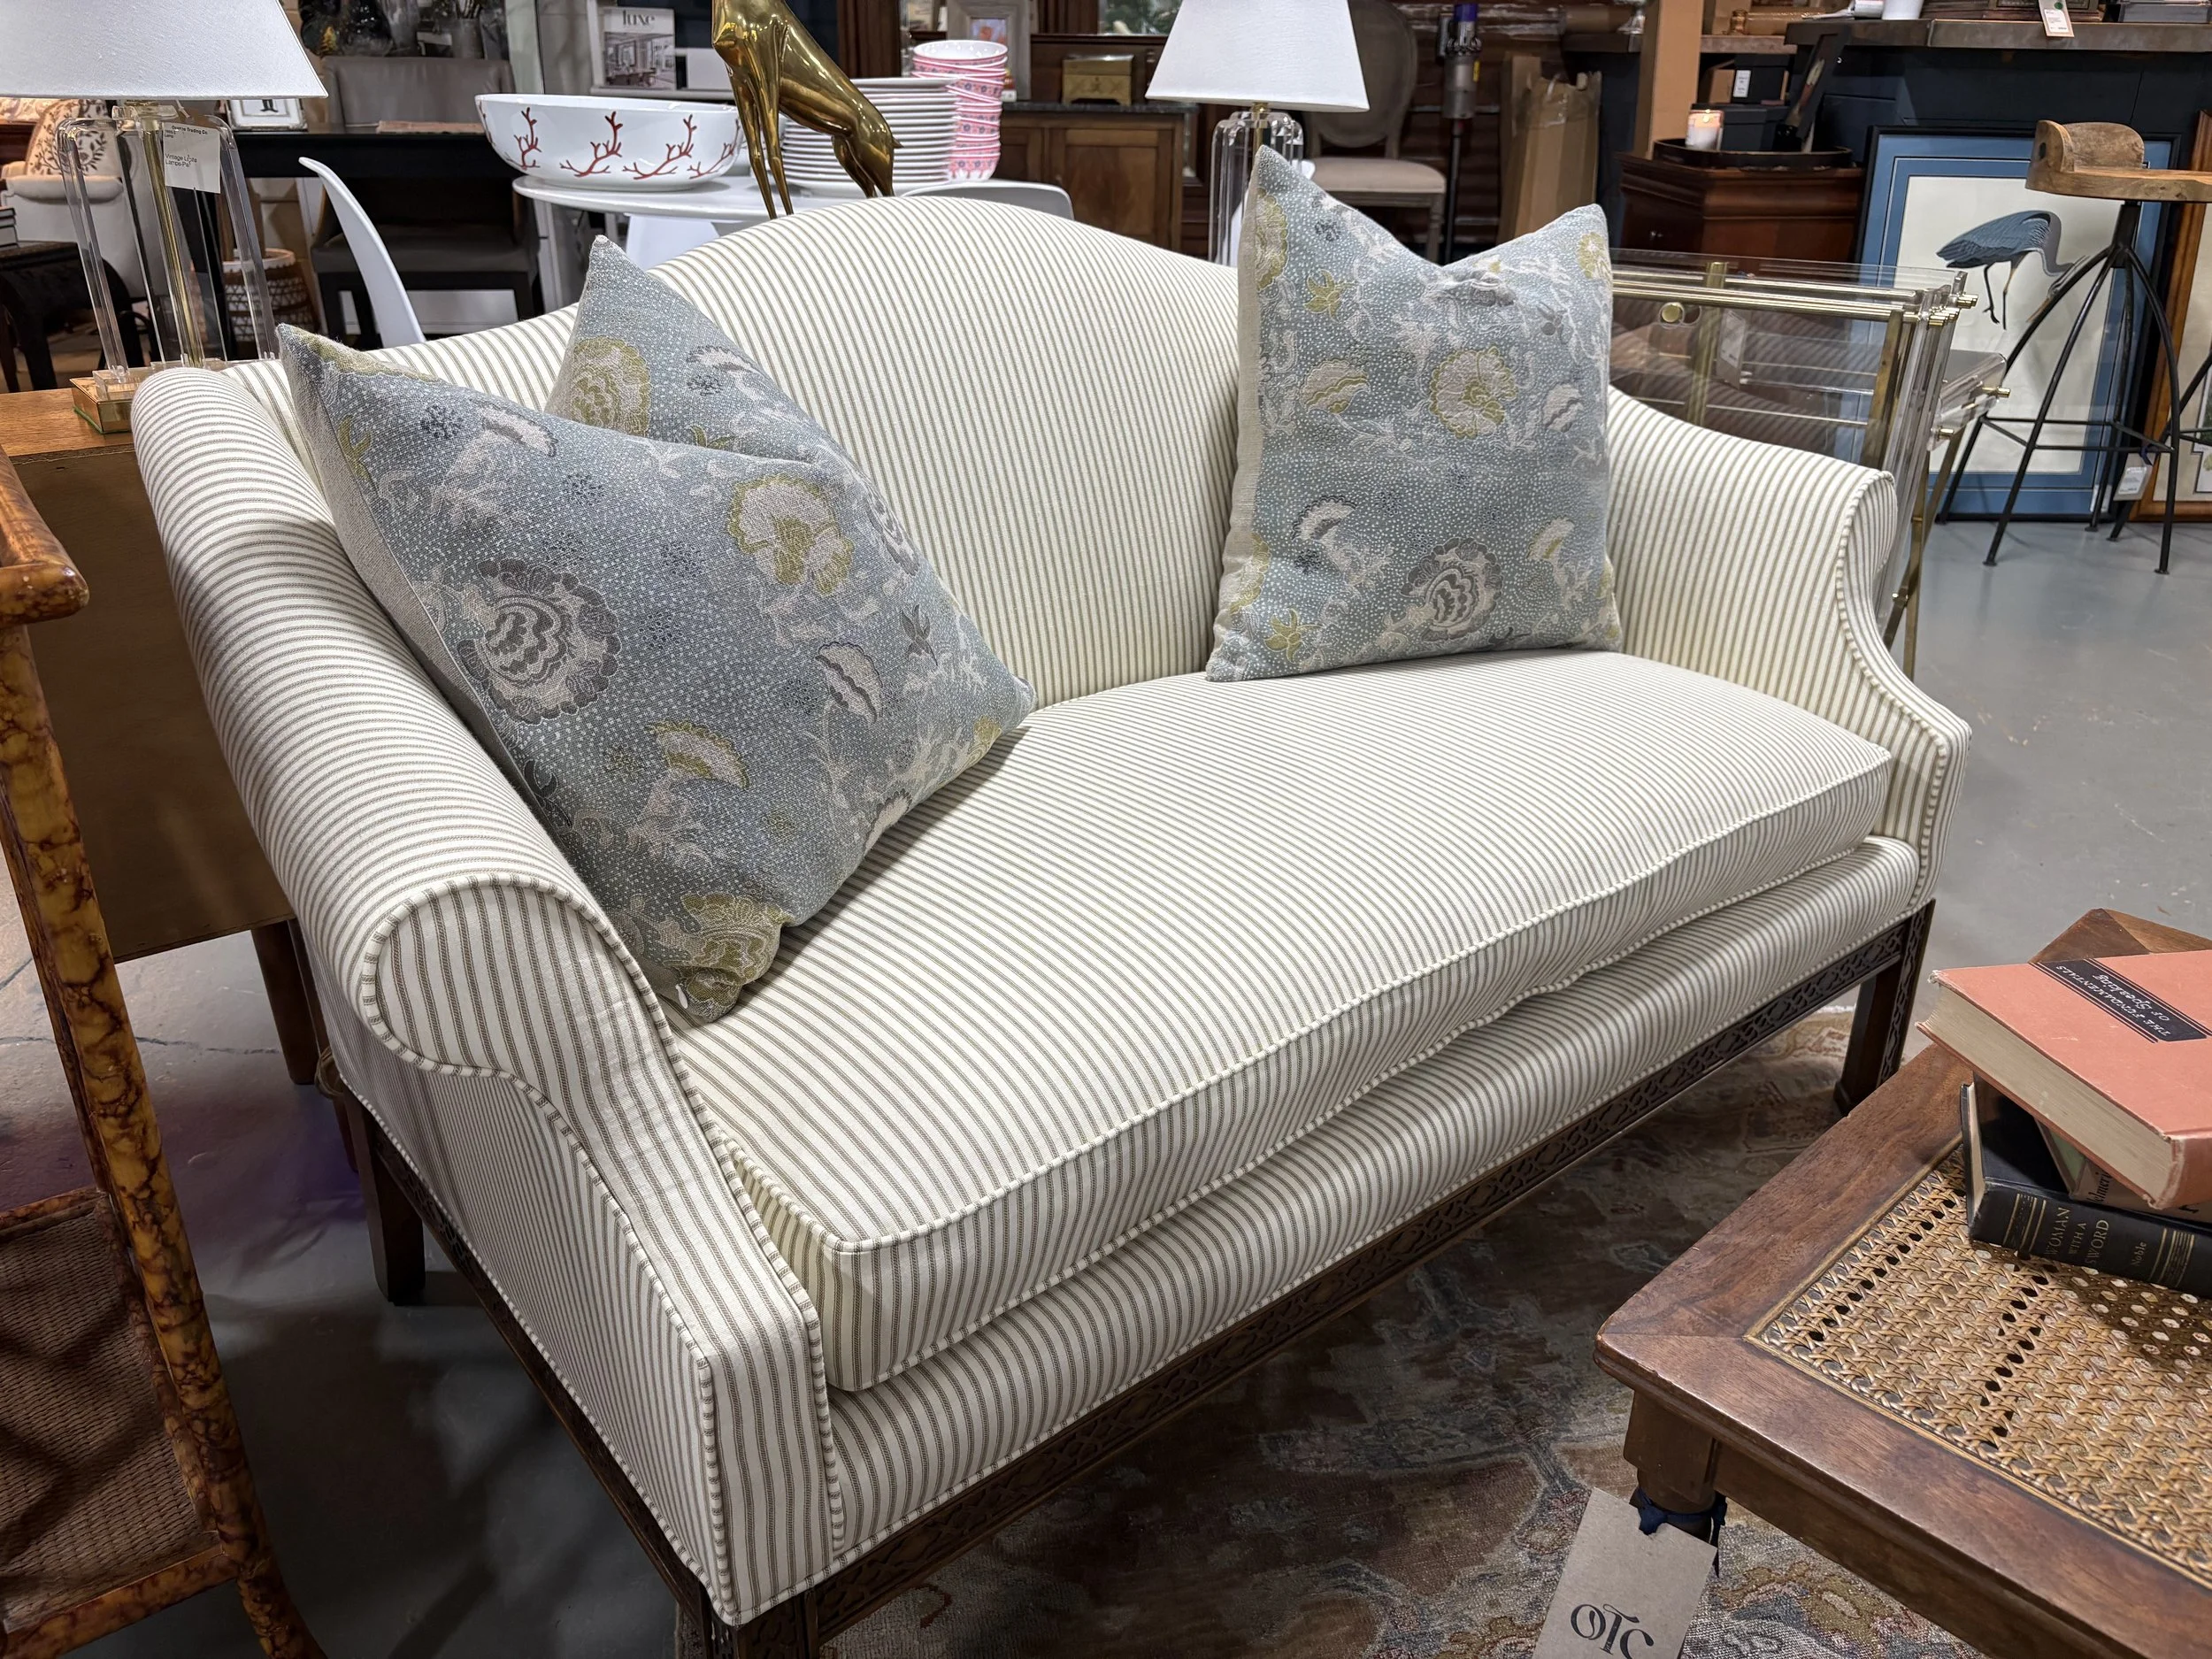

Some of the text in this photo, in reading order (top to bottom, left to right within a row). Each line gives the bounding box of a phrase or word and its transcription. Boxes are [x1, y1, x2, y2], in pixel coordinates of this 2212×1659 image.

[623, 10, 655, 26] luxe
[2055, 965, 2171, 1036] THE FUNDAMENTALS
[2093, 974, 2170, 1022] OF Speaking
[2044, 1207, 2070, 1255] WOMAN
[2068, 1232, 2085, 1255] WITH
[2085, 1219, 2109, 1264] SWORD
[2130, 1241, 2148, 1266] Noble
[1571, 1603, 1654, 1659] OTC
